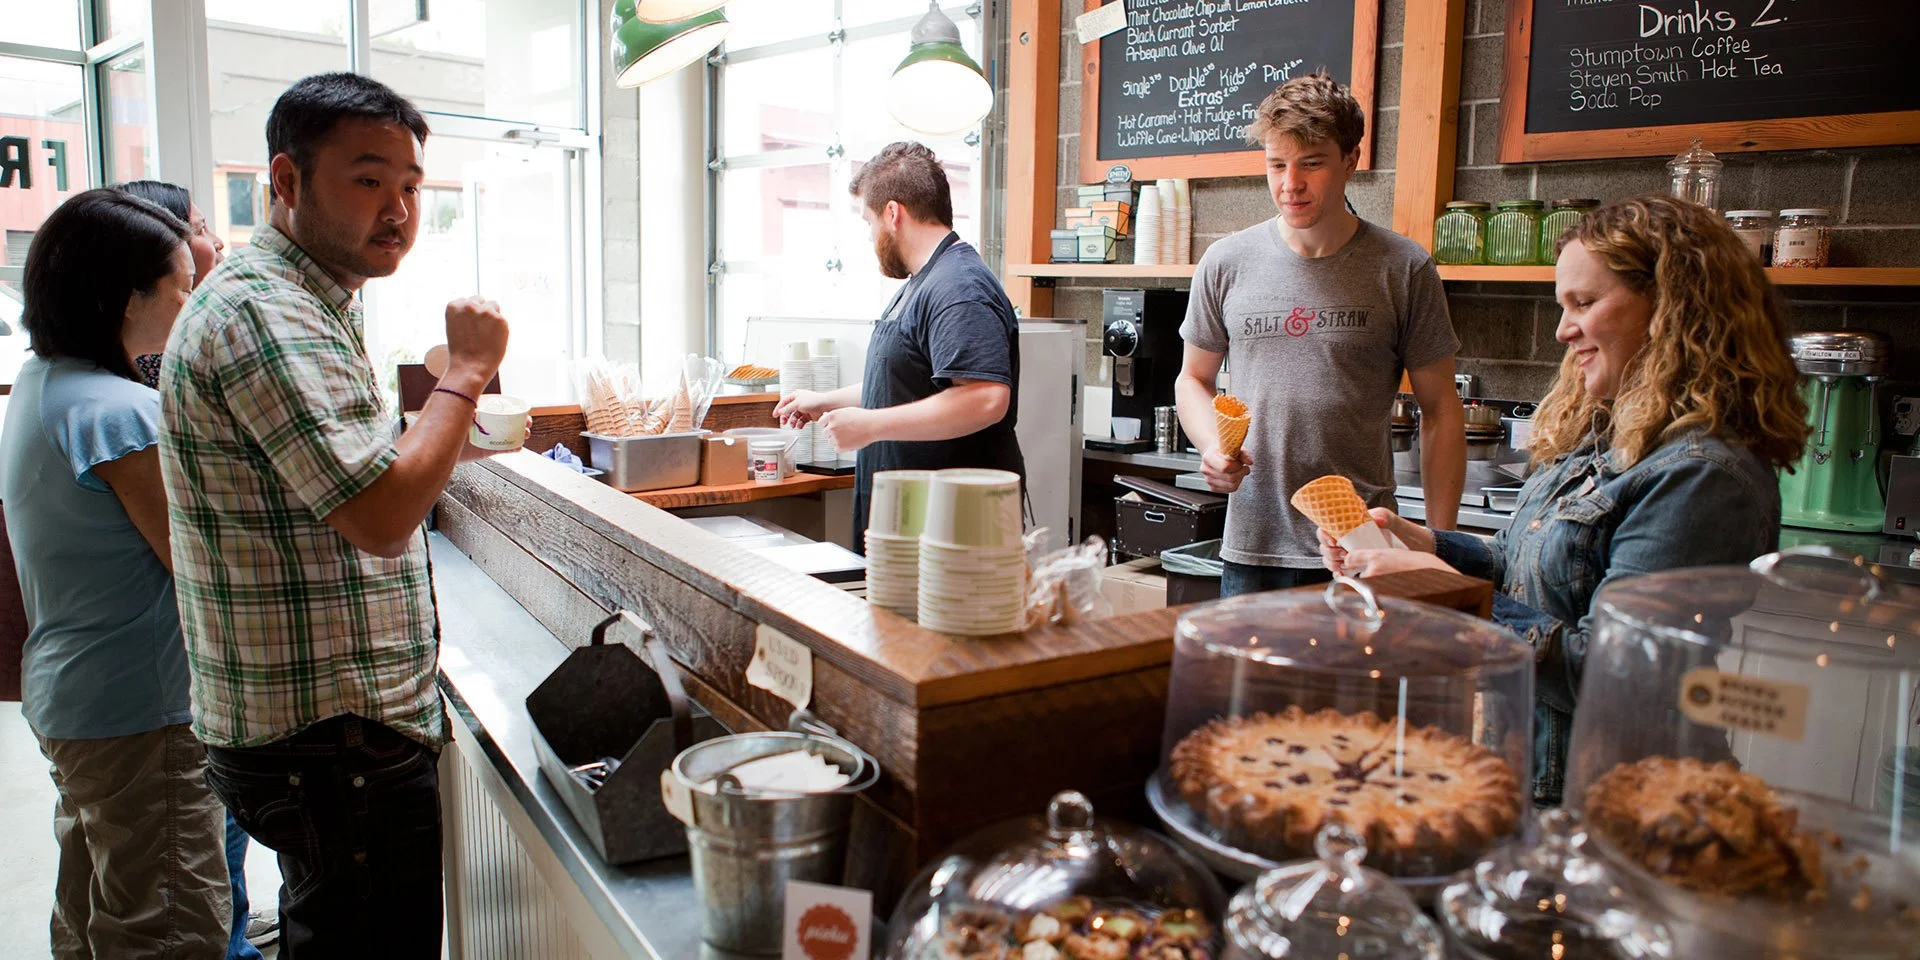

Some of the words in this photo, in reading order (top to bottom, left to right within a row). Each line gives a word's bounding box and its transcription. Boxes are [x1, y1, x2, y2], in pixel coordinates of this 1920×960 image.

[1127, 10, 1151, 27] Mint
[1153, 3, 1194, 23] Chocolate
[1195, 0, 1215, 17] Chip
[1236, 0, 1267, 12] Lemon
[1639, 1, 1736, 37] Drinks
[1126, 25, 1155, 45] Black
[1157, 20, 1196, 42] Currant
[1199, 15, 1239, 36] Sorbet
[1125, 44, 1177, 62] Arbequina
[1182, 39, 1206, 55] Olive
[1210, 35, 1224, 51] Oil
[1570, 42, 1683, 69] Stumptown
[1692, 35, 1751, 57] Coffee
[1122, 75, 1151, 98] Single
[1169, 67, 1206, 92] Double
[1220, 66, 1245, 87] Kids
[1262, 63, 1290, 82] Pint
[1569, 69, 1631, 89] Steven
[1636, 62, 1689, 84] Smith
[1700, 58, 1738, 79] Hot
[1744, 54, 1783, 75] Tea
[1178, 90, 1223, 107] Extras
[1570, 86, 1618, 111] Soda
[1629, 86, 1661, 110] Pop
[1117, 114, 1136, 130] Hot
[1138, 110, 1177, 129] Caramel
[1183, 107, 1202, 124] Hot
[1205, 105, 1235, 125] Fudge
[1117, 130, 1154, 147] Waffle
[1156, 128, 1177, 144] Cone
[1180, 124, 1220, 146] Whipped
[1244, 315, 1281, 336] SALT
[1284, 306, 1317, 337] &
[1316, 310, 1369, 329] STRAW
